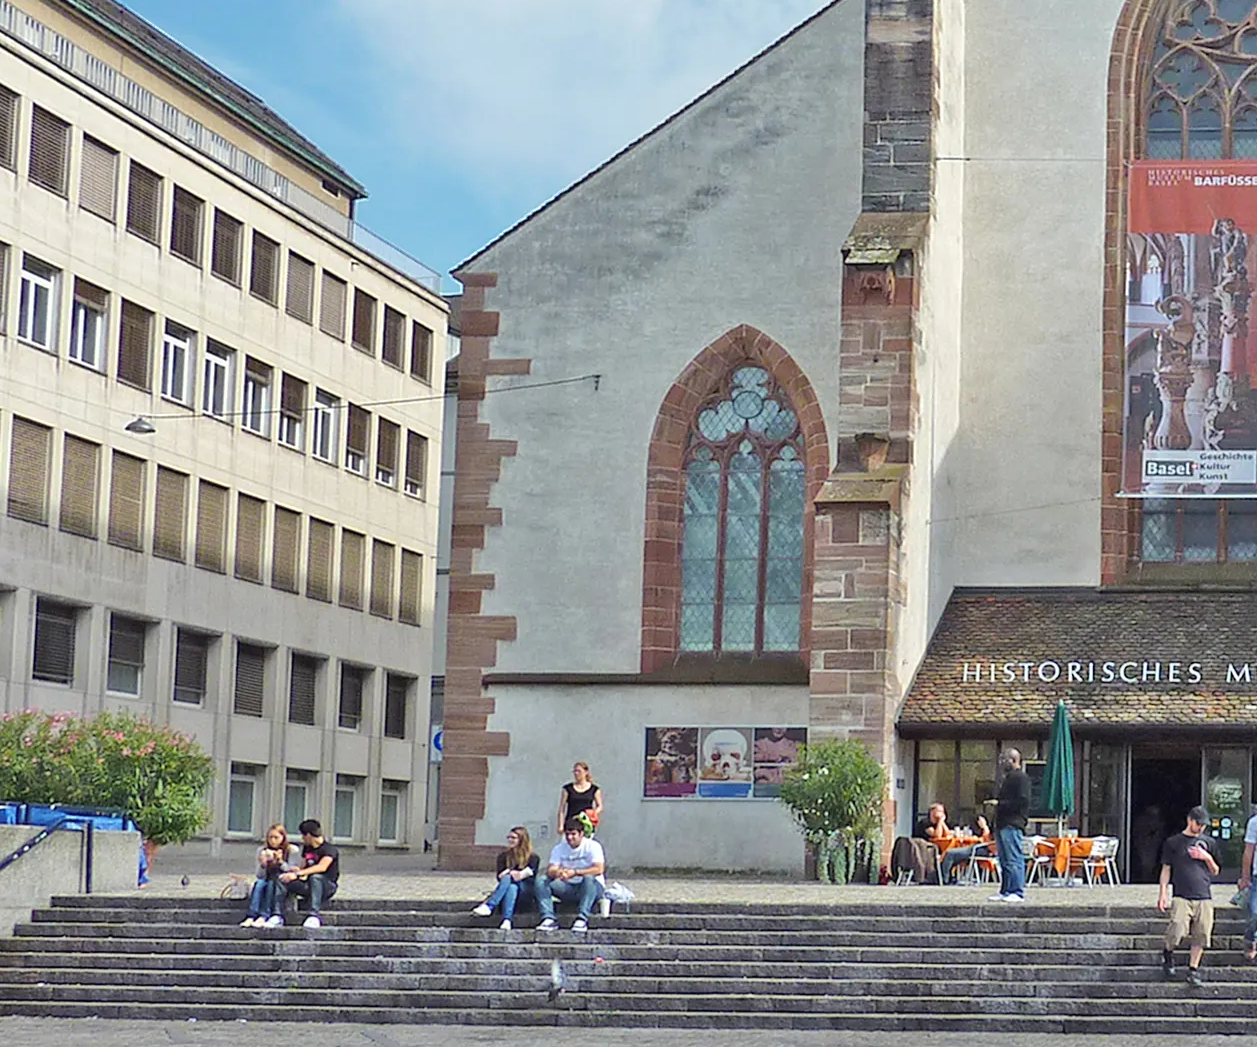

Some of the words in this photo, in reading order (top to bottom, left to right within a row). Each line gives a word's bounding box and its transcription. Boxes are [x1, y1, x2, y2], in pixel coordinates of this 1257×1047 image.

[1200, 453, 1254, 461] Geschichte
[1147, 462, 1191, 475] Basel
[961, 661, 1202, 684] HISTORISCHES
